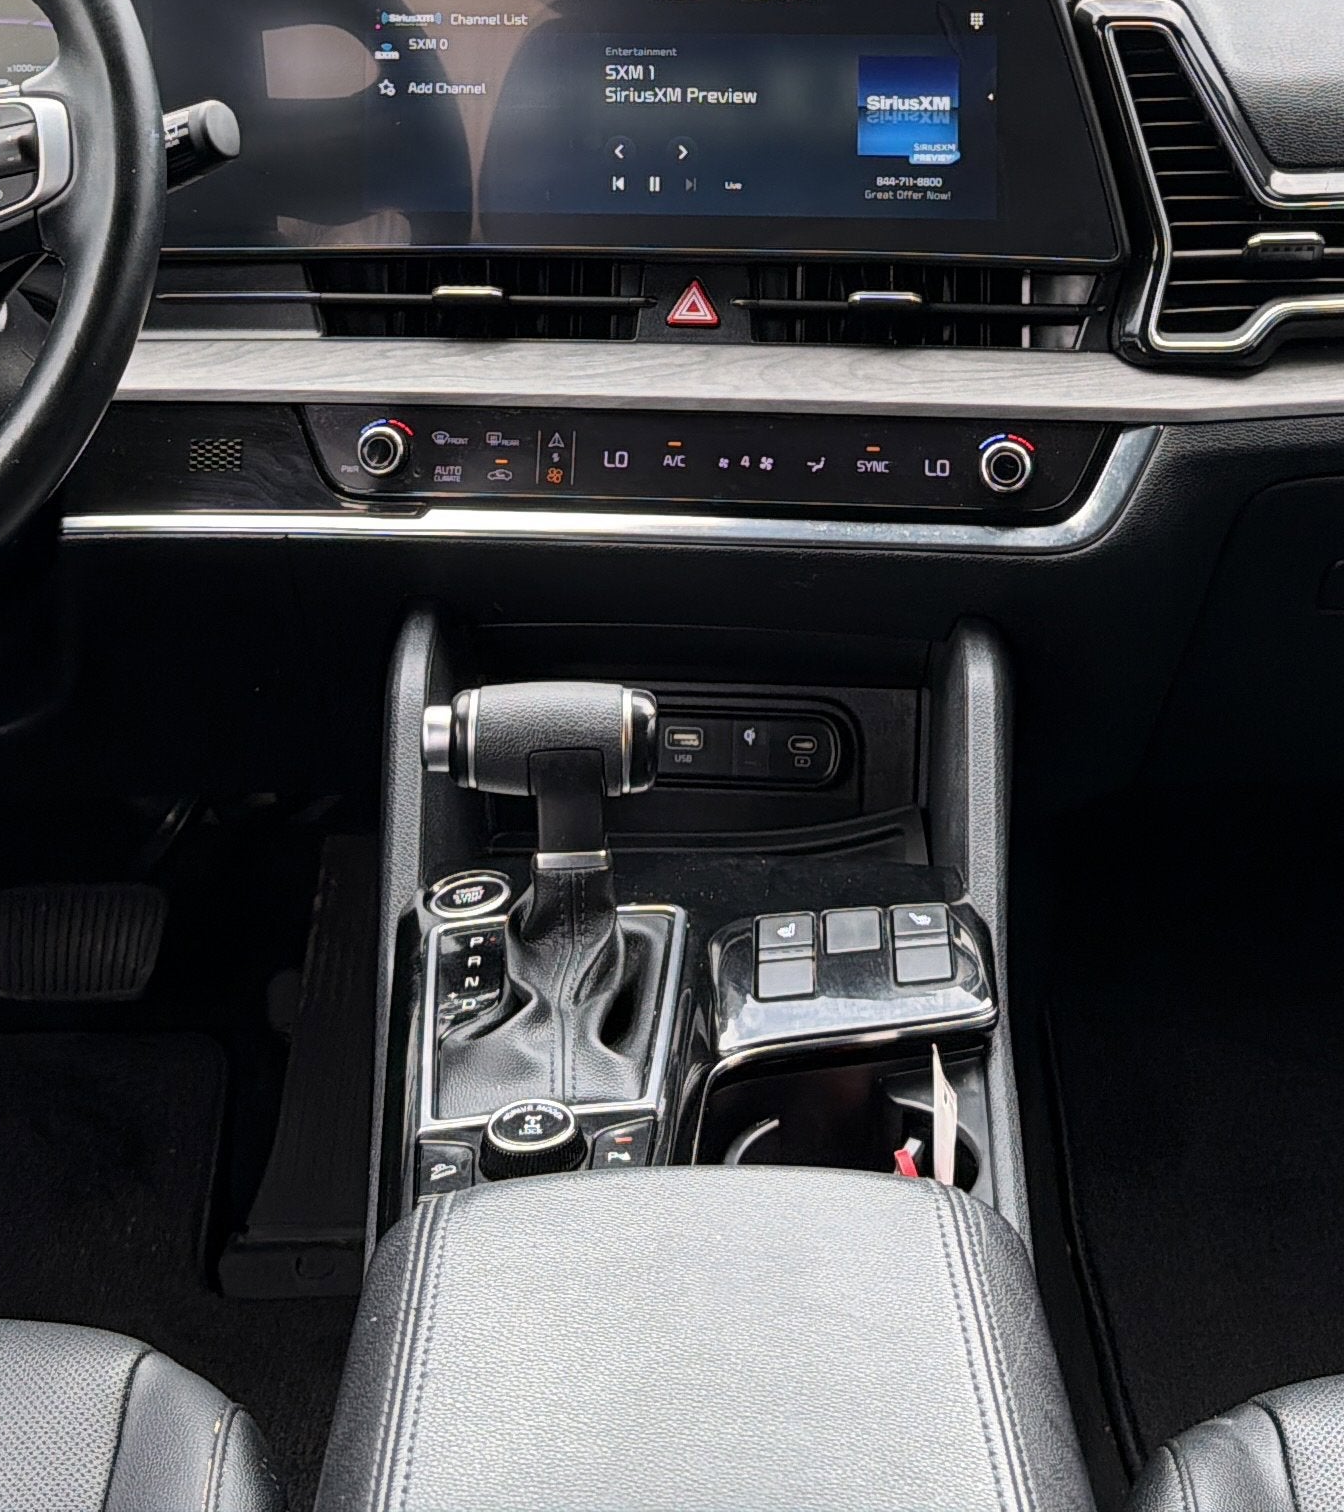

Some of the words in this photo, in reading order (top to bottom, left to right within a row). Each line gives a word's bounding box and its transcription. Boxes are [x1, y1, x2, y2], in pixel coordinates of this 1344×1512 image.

[450, 13, 501, 25] Channel
[504, 13, 528, 26] List
[408, 38, 436, 50] SXM
[605, 46, 677, 57] Entertainment
[605, 65, 644, 80] SXM
[649, 65, 655, 80] 1
[408, 82, 433, 95] Add
[436, 82, 486, 95] Channel
[605, 87, 682, 103] SiriusXM
[686, 87, 758, 104] Preview
[866, 95, 951, 111] SiriusXM
[724, 181, 742, 190] Live
[876, 176, 943, 187] 844-711-8800
[864, 189, 894, 200] Great
[896, 190, 924, 200] Offer
[926, 190, 952, 201] Now!
[447, 437, 469, 445] FRONT
[501, 439, 520, 447] REAR
[603, 450, 629, 468] LO
[662, 454, 686, 467] A/C
[740, 455, 751, 468] 4
[340, 464, 360, 473] PWR
[434, 465, 463, 476] AUTO
[856, 460, 890, 473] SYNC
[924, 459, 950, 477] LO
[674, 753, 693, 764] USB
[469, 936, 484, 948] P
[464, 975, 480, 988] N
[462, 998, 477, 1011] D
[518, 1128, 544, 1136] LOCK
